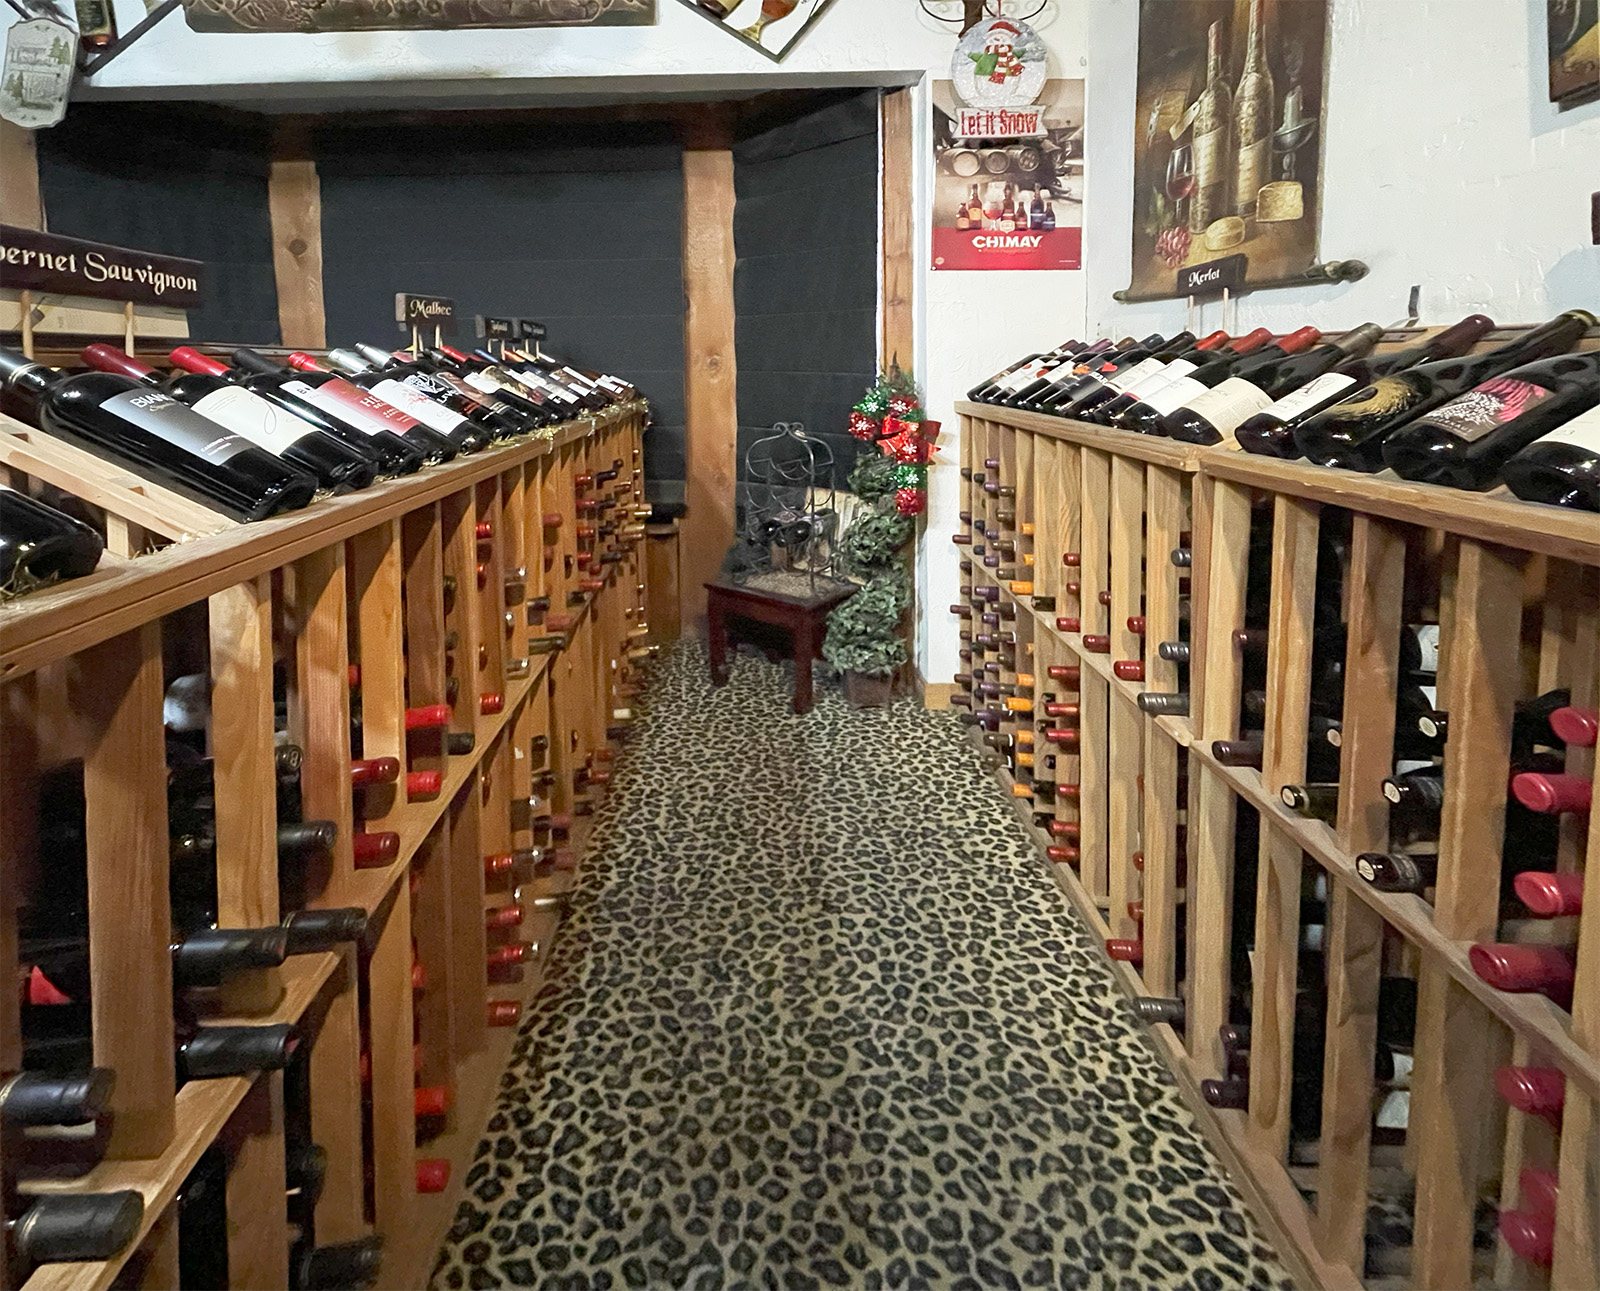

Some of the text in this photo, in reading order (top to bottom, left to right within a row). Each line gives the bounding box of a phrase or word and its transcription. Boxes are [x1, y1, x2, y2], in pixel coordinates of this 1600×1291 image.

[961, 108, 1039, 135] Let it Snow
[972, 235, 1043, 248] CHIMAY
[83, 252, 197, 295] Sauvignon
[1188, 267, 1220, 287] Merlot
[410, 299, 452, 319] Malbec
